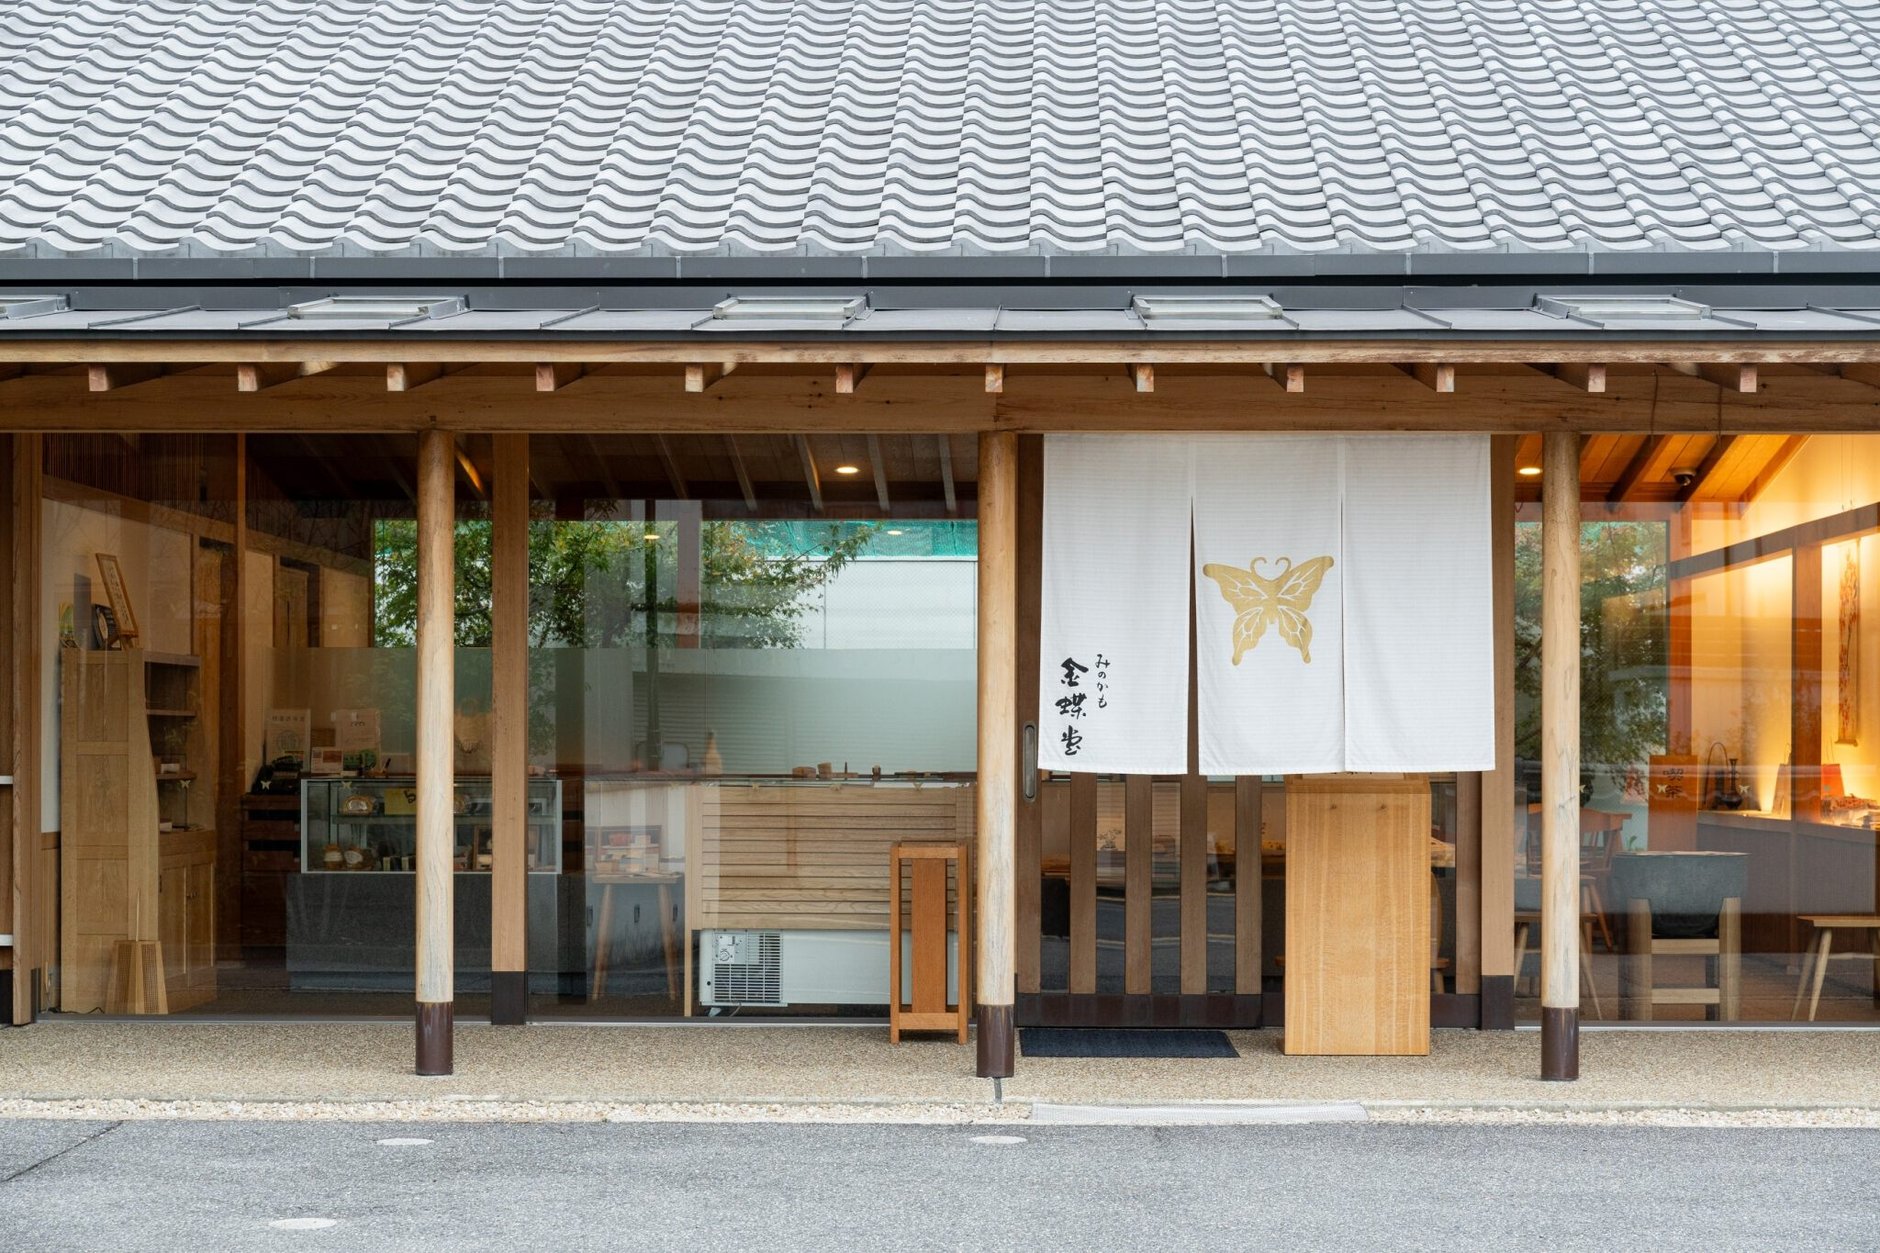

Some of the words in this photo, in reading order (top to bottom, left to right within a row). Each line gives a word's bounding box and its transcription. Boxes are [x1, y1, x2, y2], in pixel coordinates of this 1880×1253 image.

[1055, 657, 1089, 756] 金蝶堂
[1095, 654, 1110, 708] みのかも
